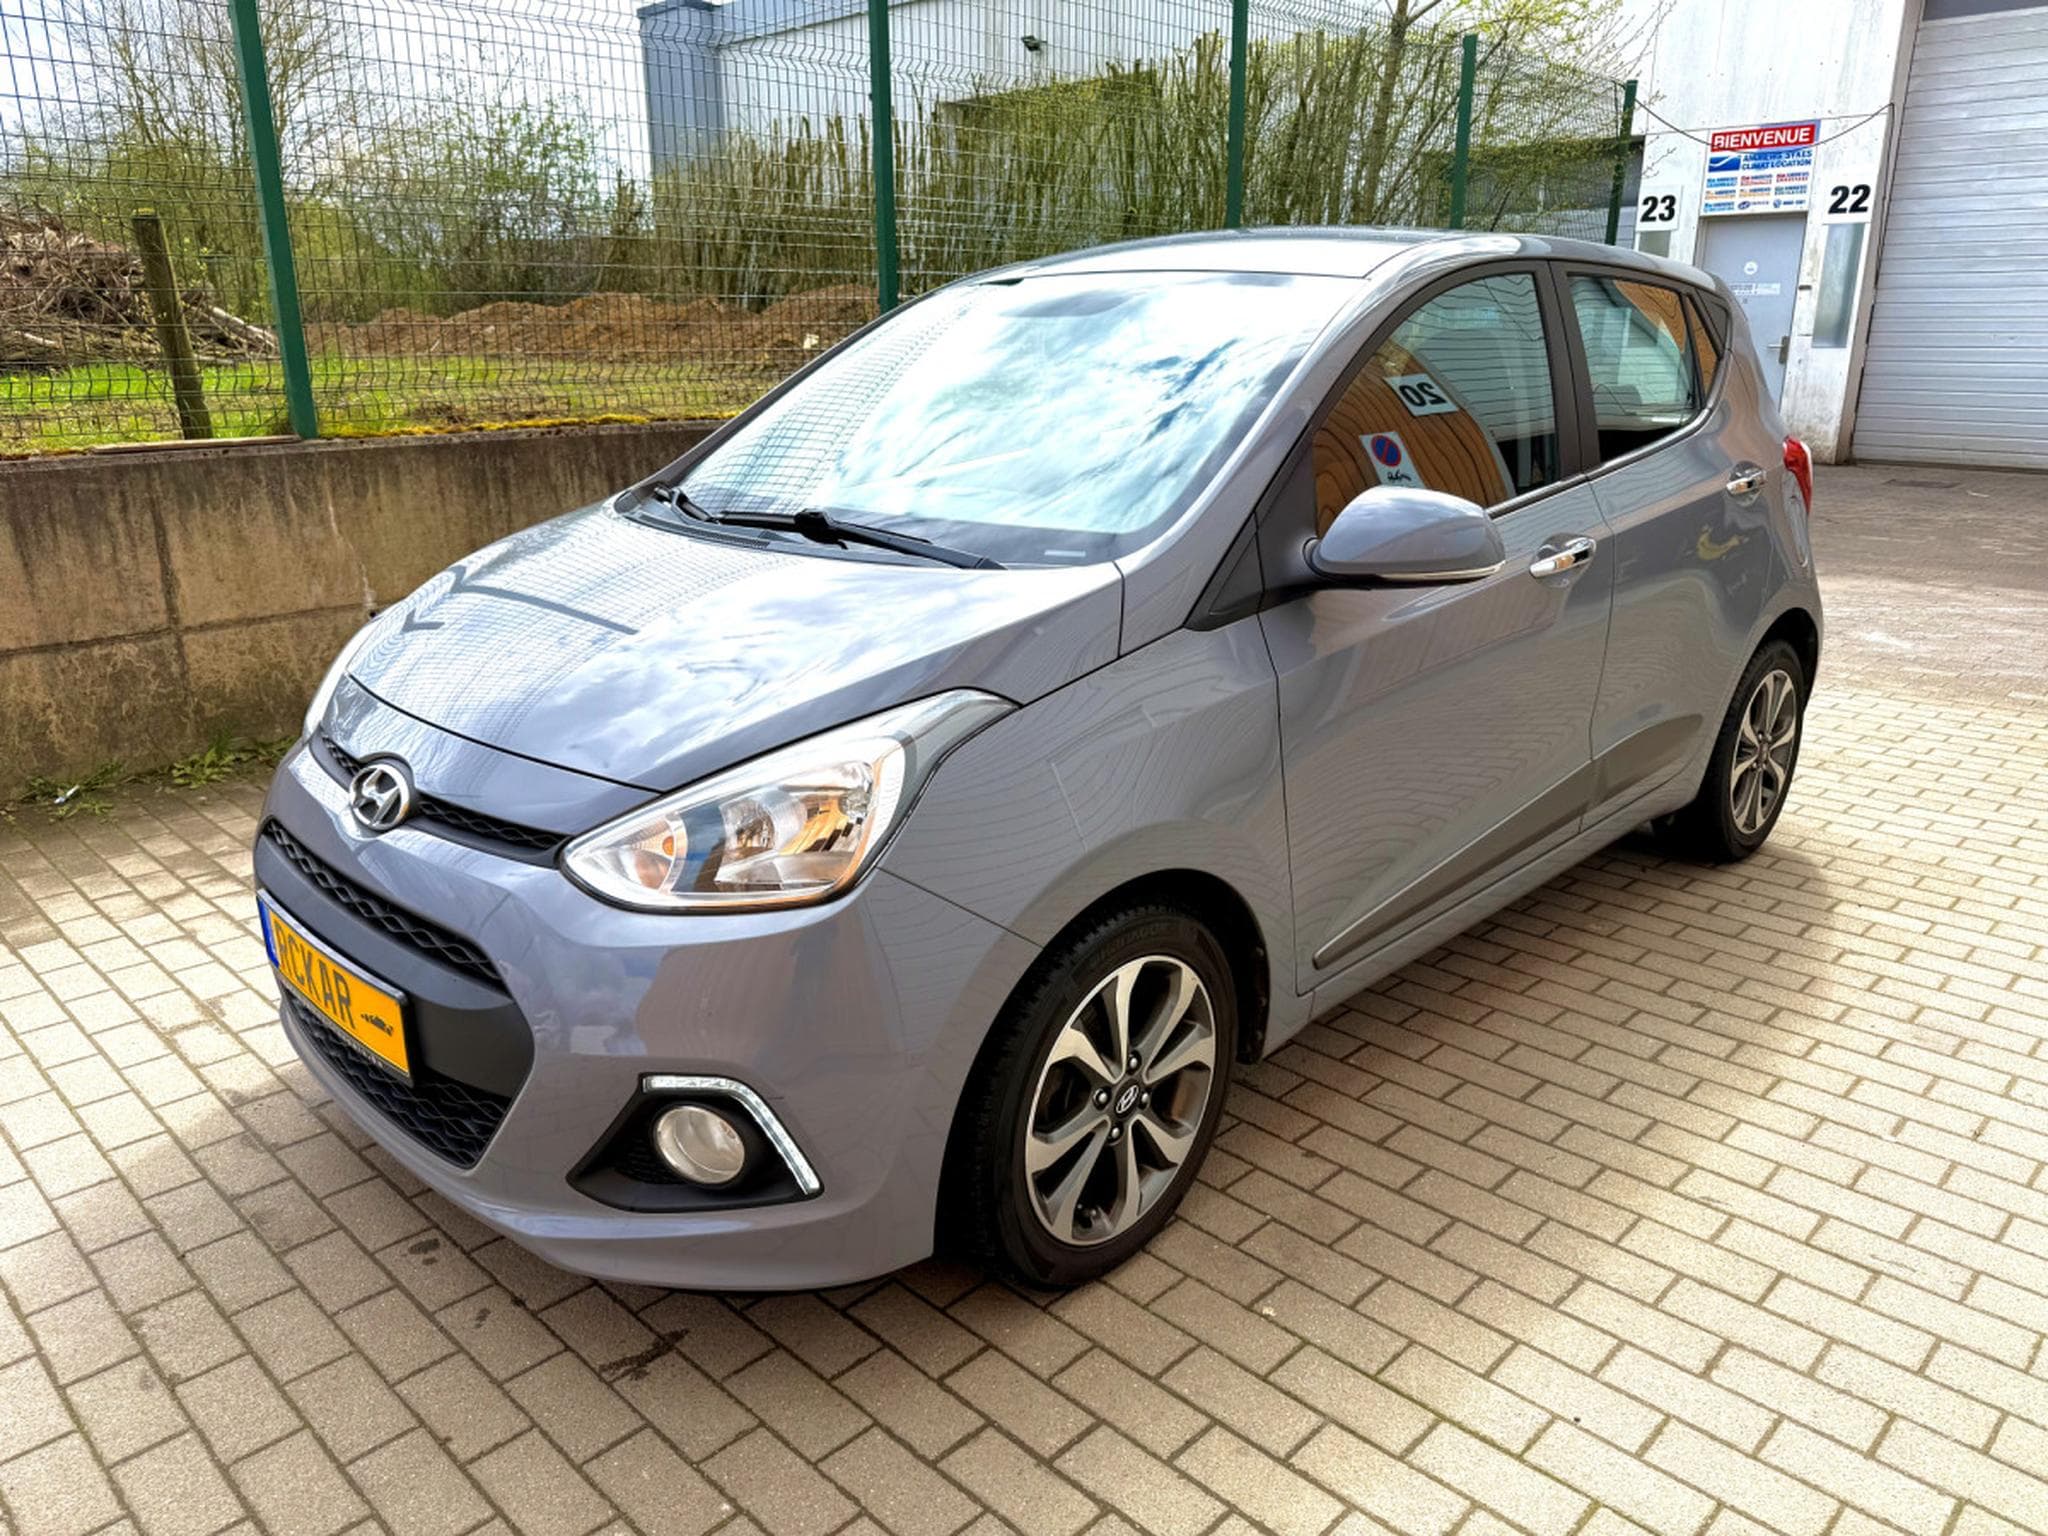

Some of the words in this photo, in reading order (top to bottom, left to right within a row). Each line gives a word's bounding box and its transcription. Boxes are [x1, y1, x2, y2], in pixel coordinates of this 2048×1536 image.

[1713, 127, 1811, 149] BIENVENUE
[1640, 195, 1677, 222] 23
[1828, 184, 1871, 214] 22
